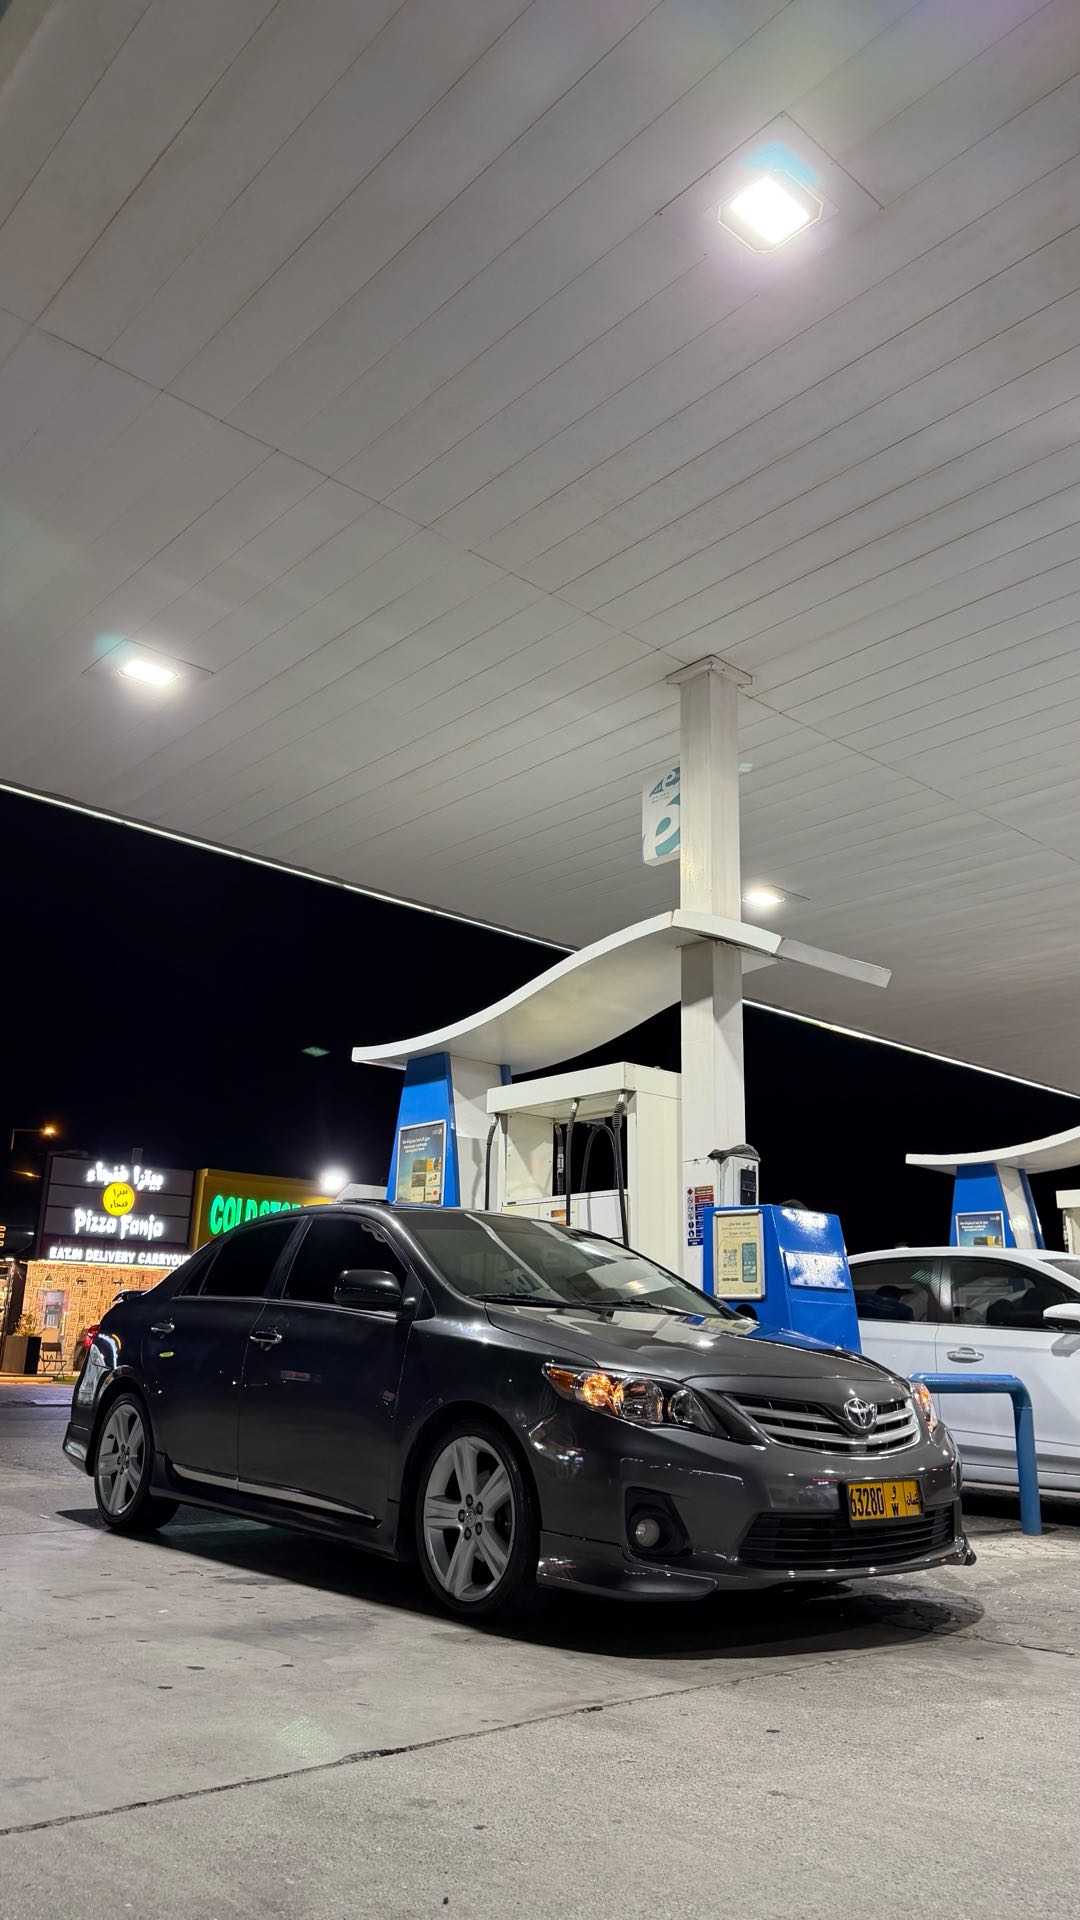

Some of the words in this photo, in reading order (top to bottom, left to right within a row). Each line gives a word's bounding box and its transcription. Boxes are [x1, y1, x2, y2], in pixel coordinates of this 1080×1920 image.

[74, 1208, 118, 1235] Pizza
[120, 1214, 164, 1241] Fanja
[85, 1249, 136, 1264] DELIVERY
[849, 1487, 885, 1517] 63280
[891, 1502, 899, 1516] W
